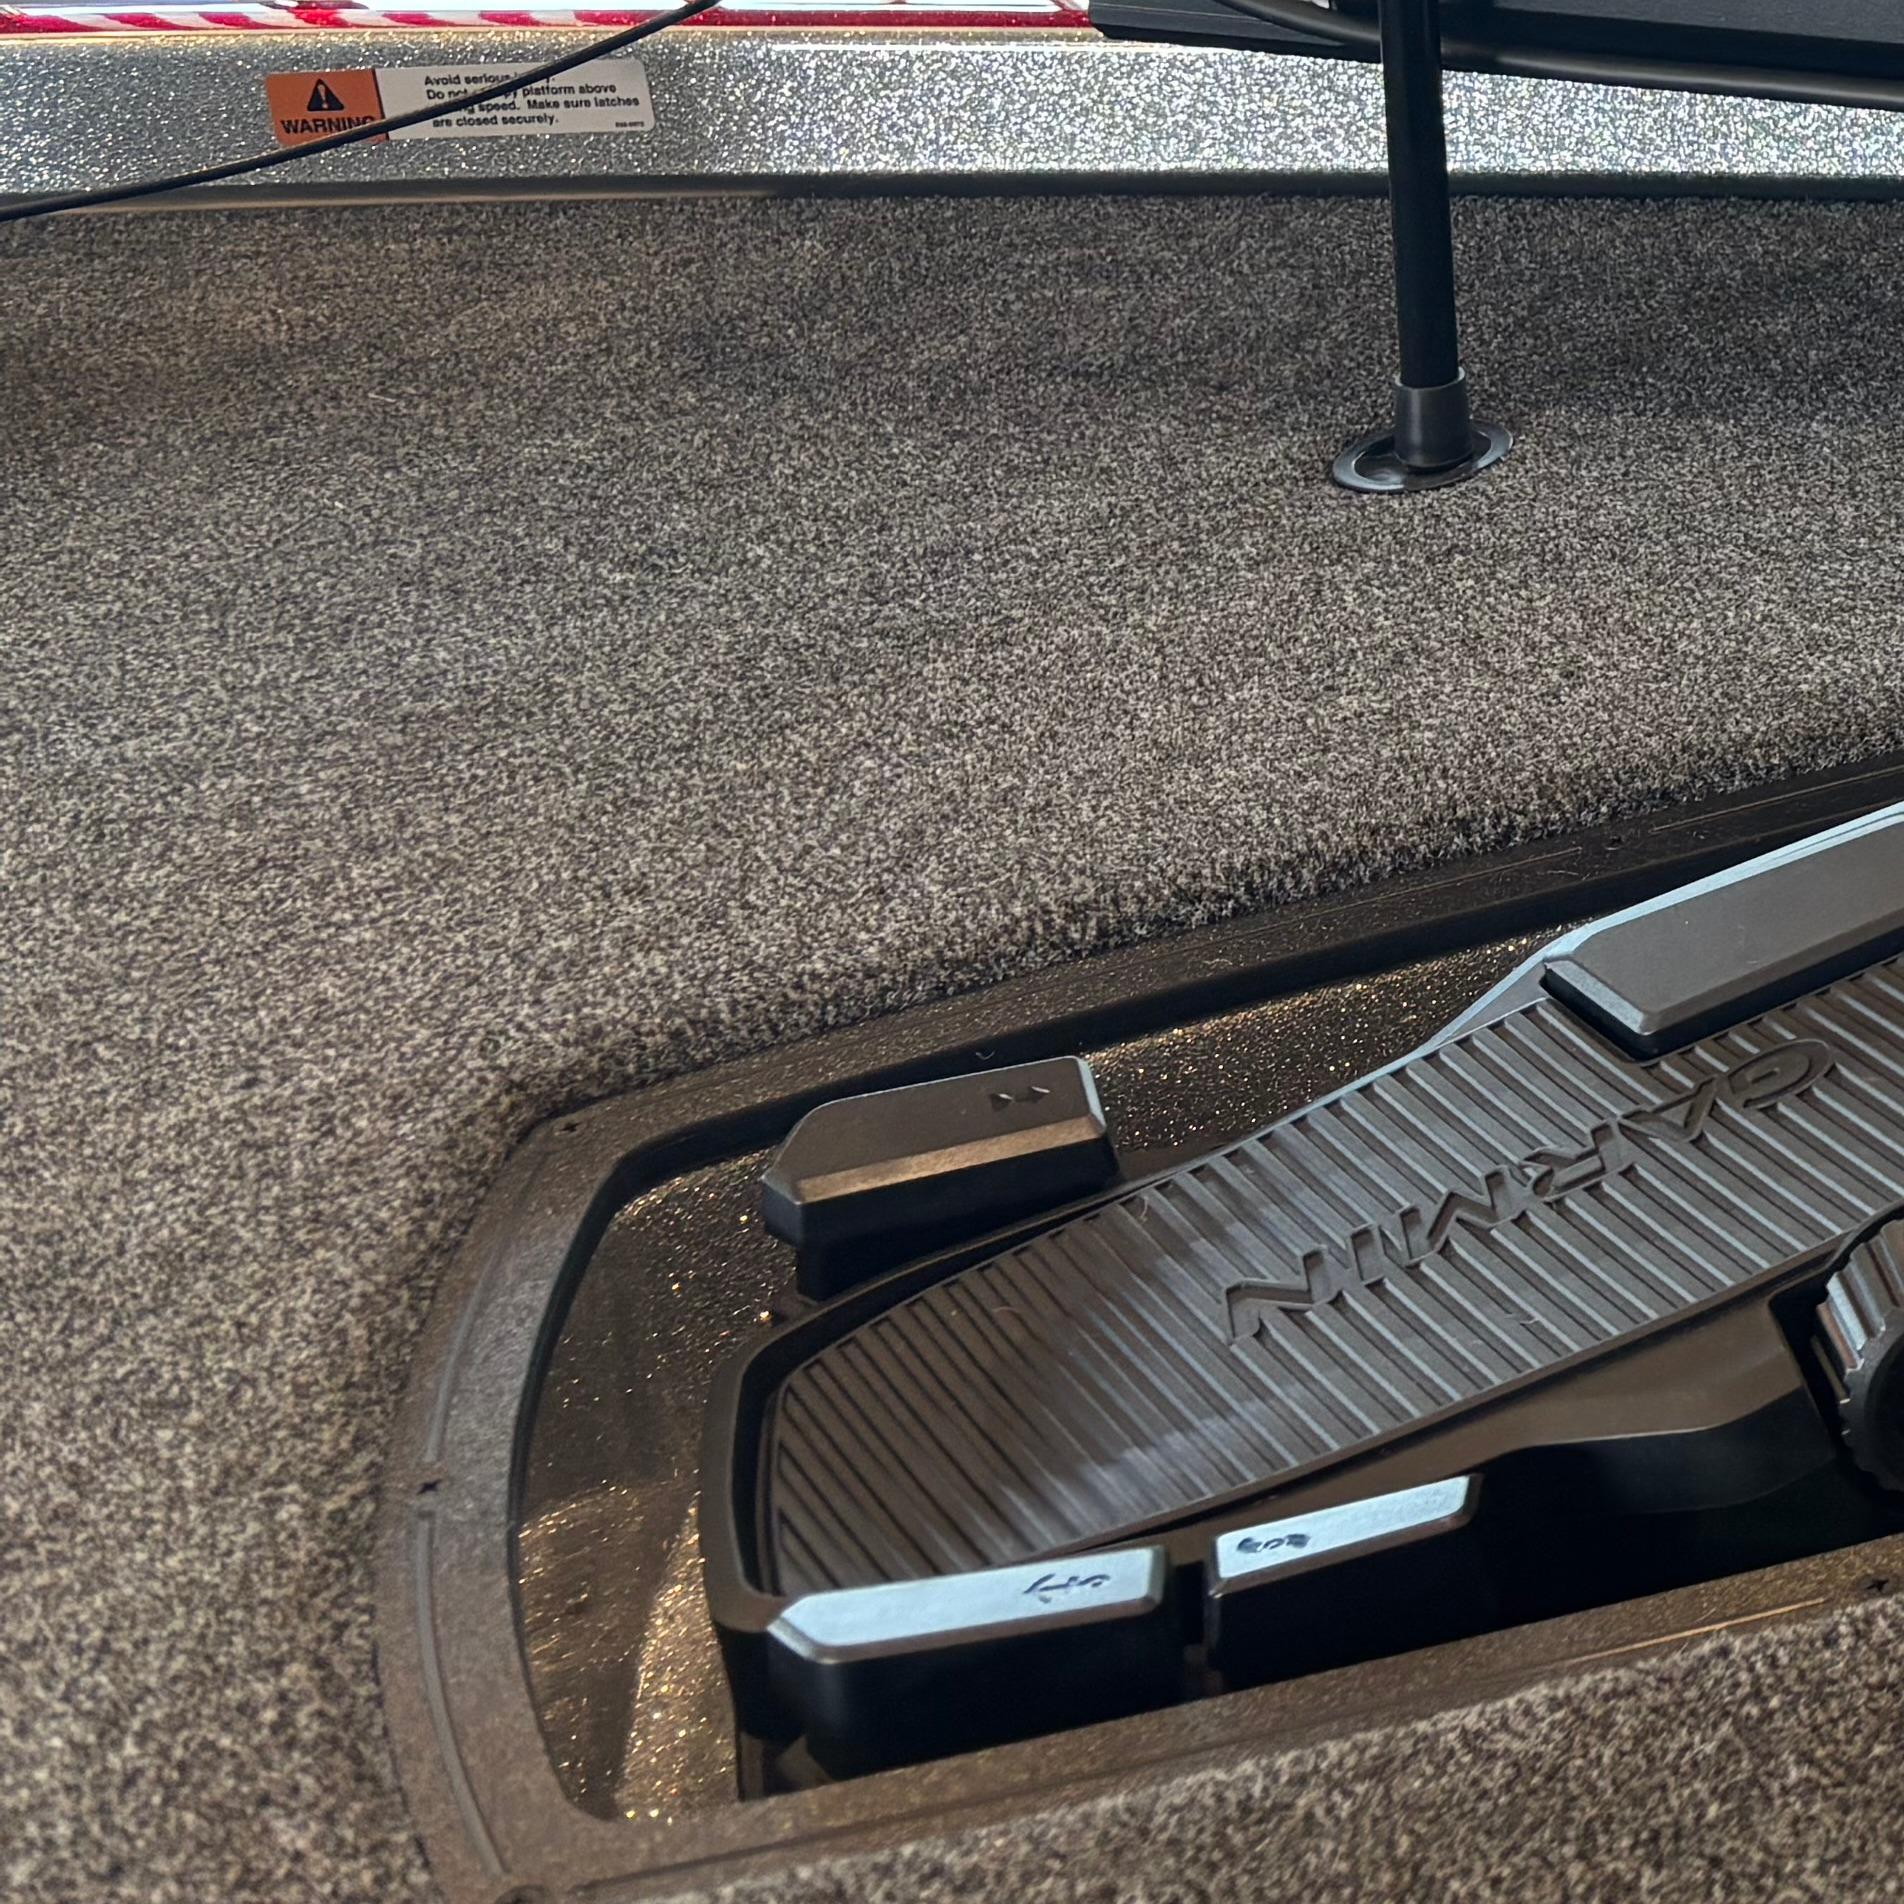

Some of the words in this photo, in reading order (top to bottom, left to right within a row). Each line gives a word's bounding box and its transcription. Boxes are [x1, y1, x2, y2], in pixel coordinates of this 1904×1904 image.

[424, 75, 461, 86] Avoid
[426, 89, 445, 100] Do
[522, 85, 575, 97] platform
[579, 84, 617, 94] above
[478, 102, 520, 114] speed.
[527, 99, 560, 110] Make
[564, 98, 591, 109] sure
[594, 96, 640, 108] latches
[432, 118, 452, 129] are
[456, 115, 498, 127] closed
[502, 113, 560, 126] securely.
[1218, 1036, 1844, 1346] GARMIN
